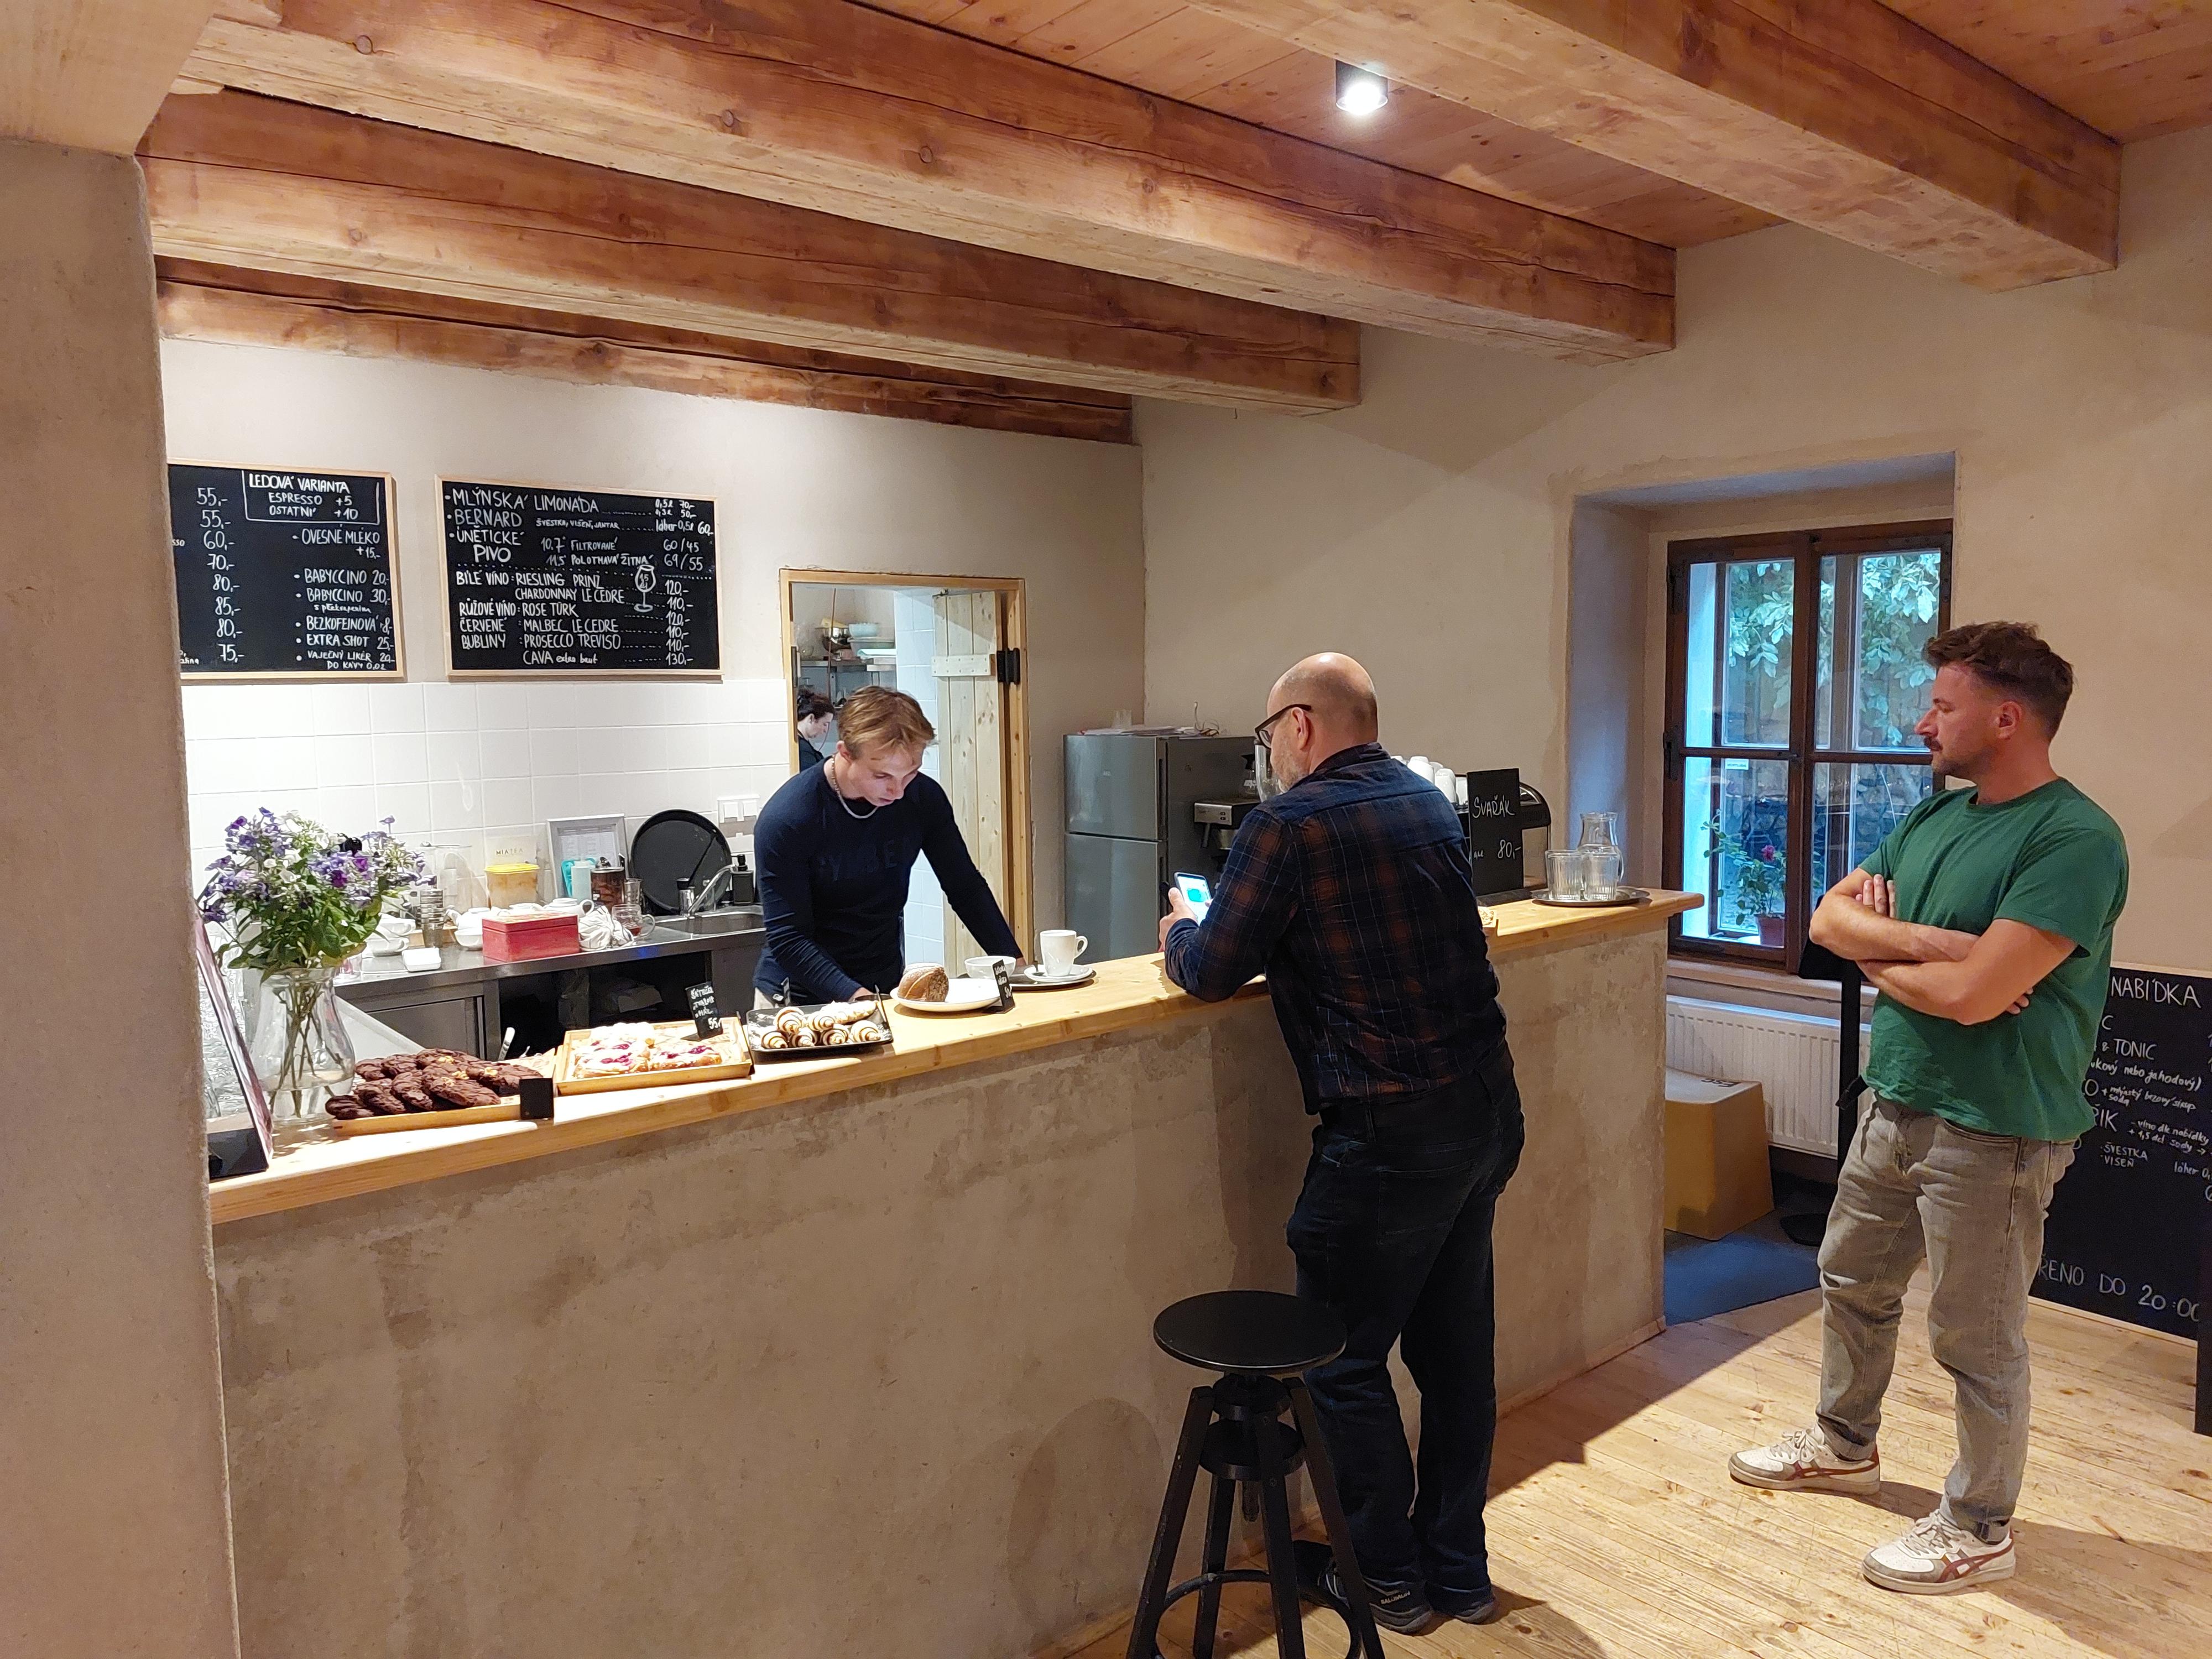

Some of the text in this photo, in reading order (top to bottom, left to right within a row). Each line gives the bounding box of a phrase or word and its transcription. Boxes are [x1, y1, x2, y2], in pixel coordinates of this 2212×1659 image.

[249, 473, 351, 494] LEDOVÁ VARIANTA
[196, 487, 228, 507] 55,-
[268, 492, 353, 507] ESPRESSO +5
[452, 486, 528, 510] MLÝNSKÁ
[534, 494, 599, 513] LIMONÁDA
[200, 509, 231, 529] 55,-
[269, 505, 358, 520] OSTATNÍ +10
[455, 509, 522, 528] BERNARD
[594, 521, 620, 530] JANTAR
[204, 530, 235, 551] 60,-
[301, 524, 380, 545] OVESNÉ MLÉKO
[456, 525, 525, 546] ÚNĚTICKÉ
[571, 536, 618, 551] FILTROVANÉ
[206, 554, 236, 571] 70,-
[473, 544, 512, 564] PIVO
[620, 553, 654, 566] ŽITNÁ
[212, 573, 241, 593] 80,-
[304, 568, 390, 586] BABYCCINO 20,-
[456, 570, 483, 586] BÍLÉ
[515, 572, 566, 586] RIESLING
[573, 574, 604, 589] PRINZ
[665, 579, 690, 597] 120,-
[215, 596, 242, 617] 85,-
[306, 587, 391, 606] BABYCCINO 30,-
[515, 587, 694, 612] CHARDONNAY LE CEDRE 110,-
[459, 597, 494, 617] RŮŽOVÉ
[523, 603, 547, 617] ROSE
[665, 610, 691, 627] 120,-
[216, 618, 243, 639] 80,-
[306, 614, 379, 632] BEZKOFEINOVÁ
[460, 617, 690, 640] ČERVENÉ MALBEC LE CEDRE 110,-
[306, 633, 341, 647] EXTRA
[342, 635, 370, 648] SHOT
[461, 633, 690, 653] BUBLINY PROSECCO TREVISO 110,-
[217, 644, 246, 663] 75,-
[307, 649, 344, 660] VAJEČNÝ
[347, 651, 373, 663] LIKÉR
[523, 650, 694, 666] CAVA extra brut 130,-
[327, 660, 339, 670] DO
[342, 661, 363, 669] KÁVY
[1497, 839, 1522, 860] 80,-
[2111, 975, 2201, 1009] NABÍDKA
[2113, 1037, 2157, 1061] TONIC
[2124, 1065, 2145, 1077] nebo
[2169, 1139, 2193, 1154] sody
[2172, 1128, 2209, 1146] nabídky
[2103, 1141, 2148, 1162] ŠVESTKA
[2099, 1273, 2126, 1296] DO
